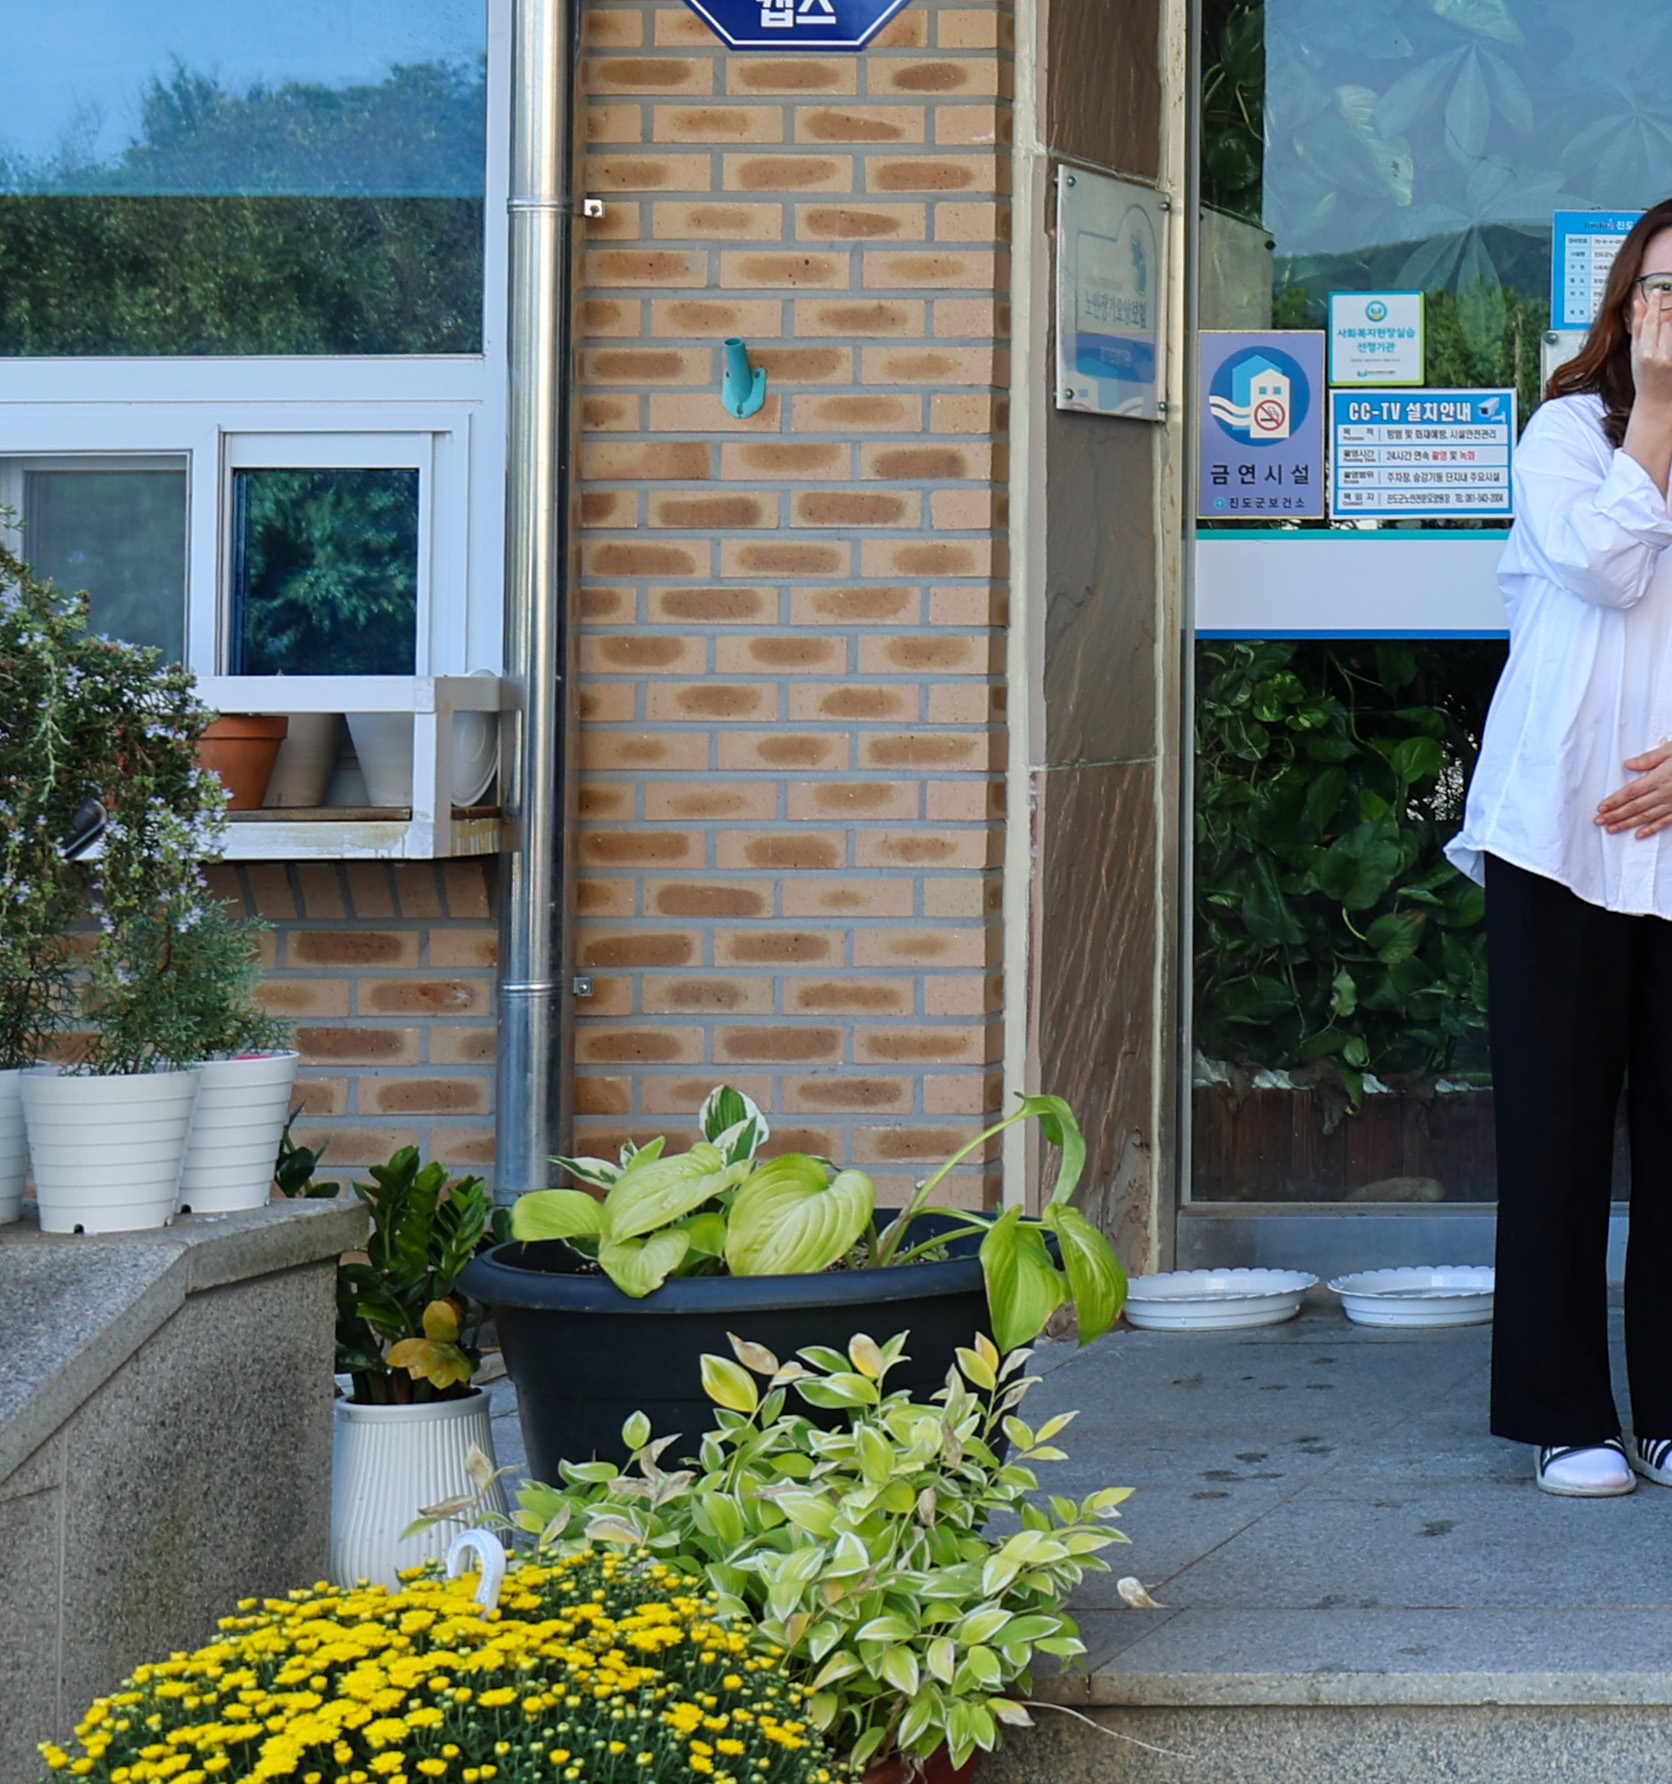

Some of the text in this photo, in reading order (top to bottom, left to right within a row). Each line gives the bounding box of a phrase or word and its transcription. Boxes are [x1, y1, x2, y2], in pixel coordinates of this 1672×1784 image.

[1349, 402, 1472, 422] CC-TV 설치안내
[1210, 464, 1310, 485] 금연시설
[1229, 497, 1305, 509] 진도군보건소
